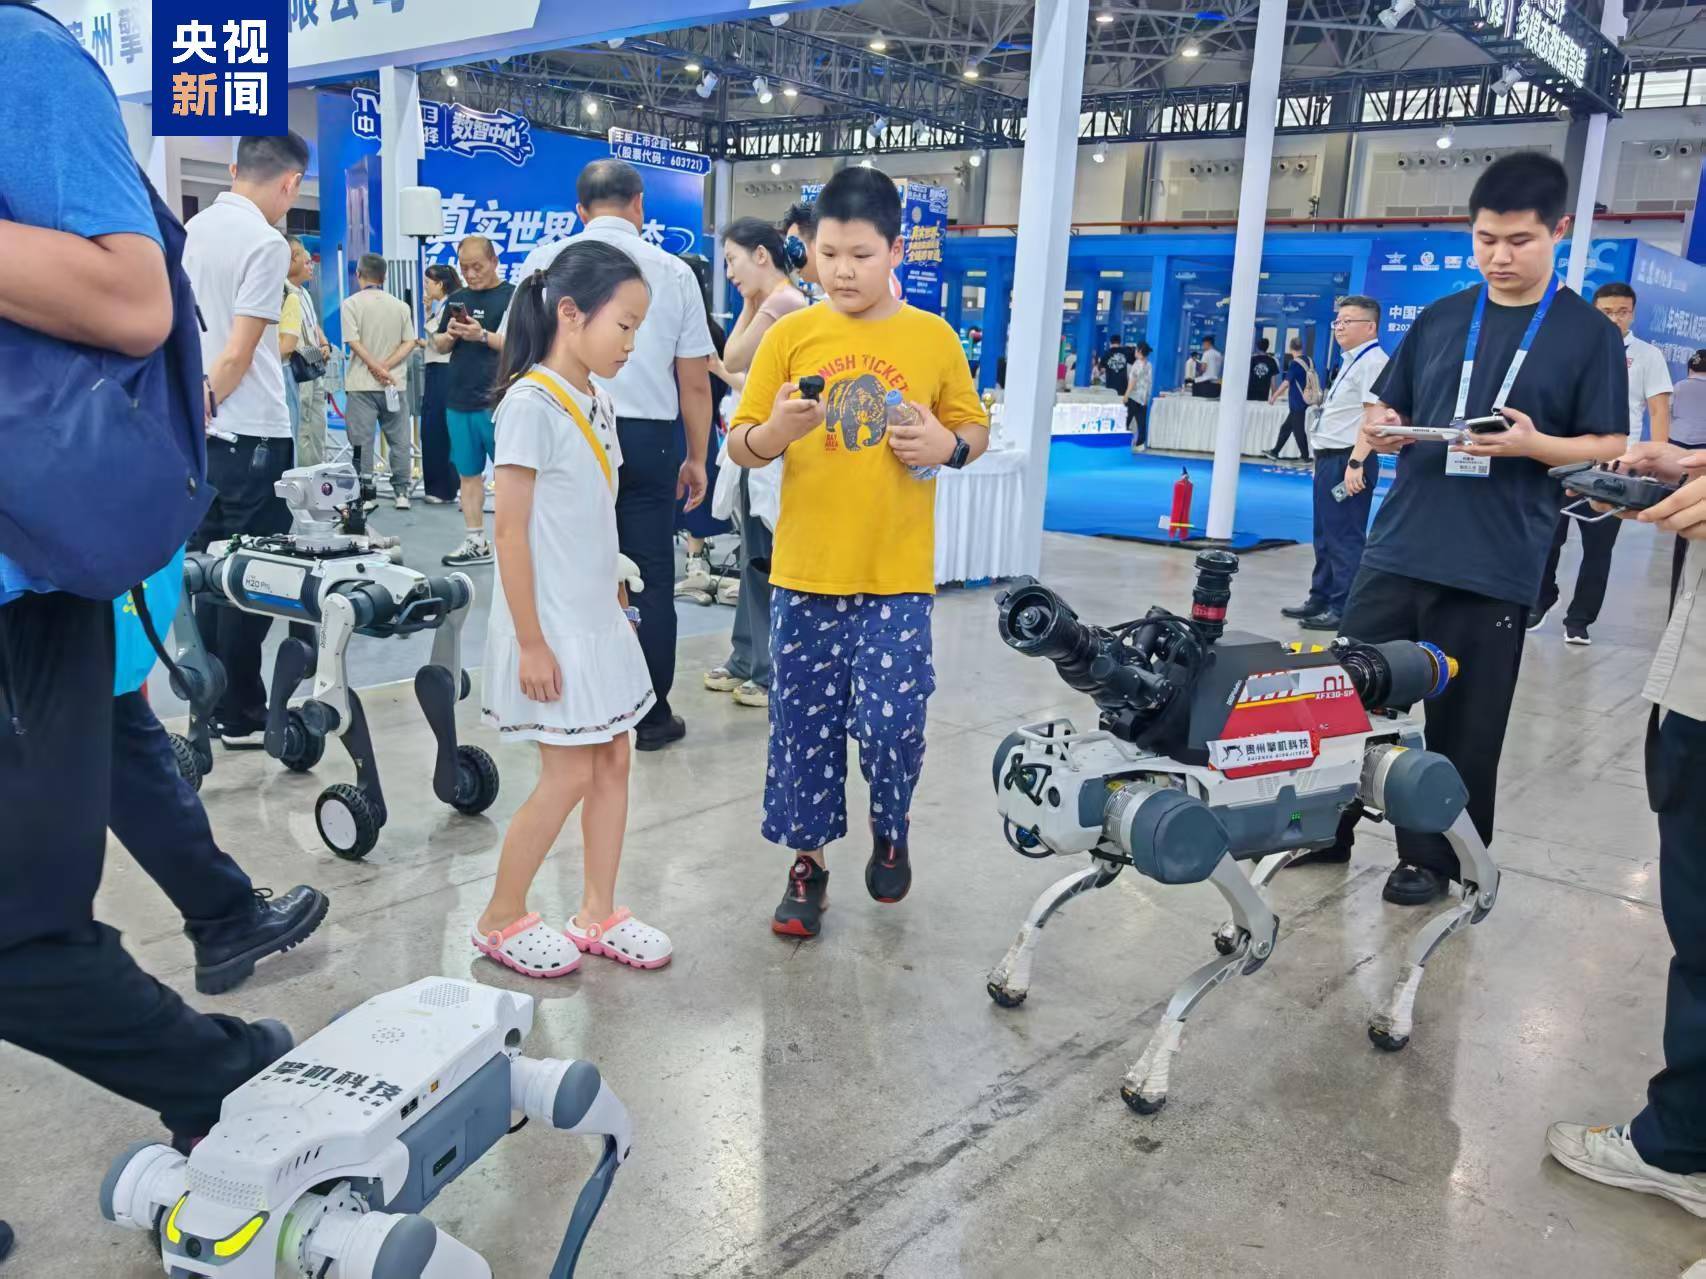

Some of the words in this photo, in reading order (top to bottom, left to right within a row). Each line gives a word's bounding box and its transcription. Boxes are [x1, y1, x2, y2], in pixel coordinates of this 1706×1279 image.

[451, 110, 521, 147] 数智中心
[862, 354, 909, 392] TICKET
